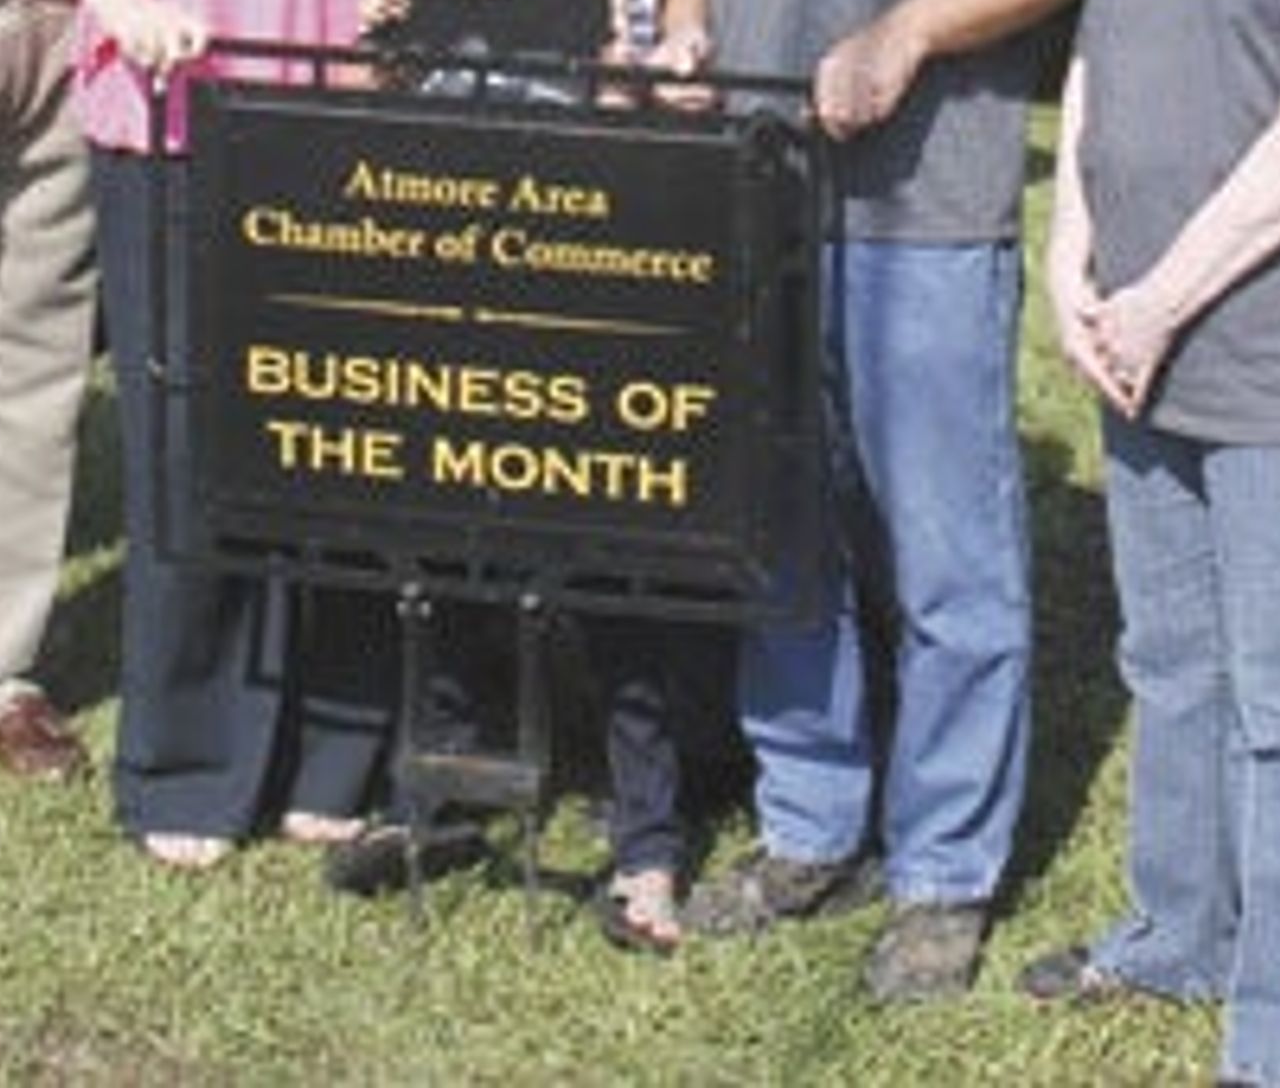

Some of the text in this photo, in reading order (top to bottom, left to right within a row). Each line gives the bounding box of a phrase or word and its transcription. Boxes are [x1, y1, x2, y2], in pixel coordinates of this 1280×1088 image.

[344, 159, 610, 217] Atmore Area
[242, 206, 715, 284] Chamber of Commerce
[246, 344, 717, 431] BUSINESS OF
[267, 419, 688, 506] THE MONTH
